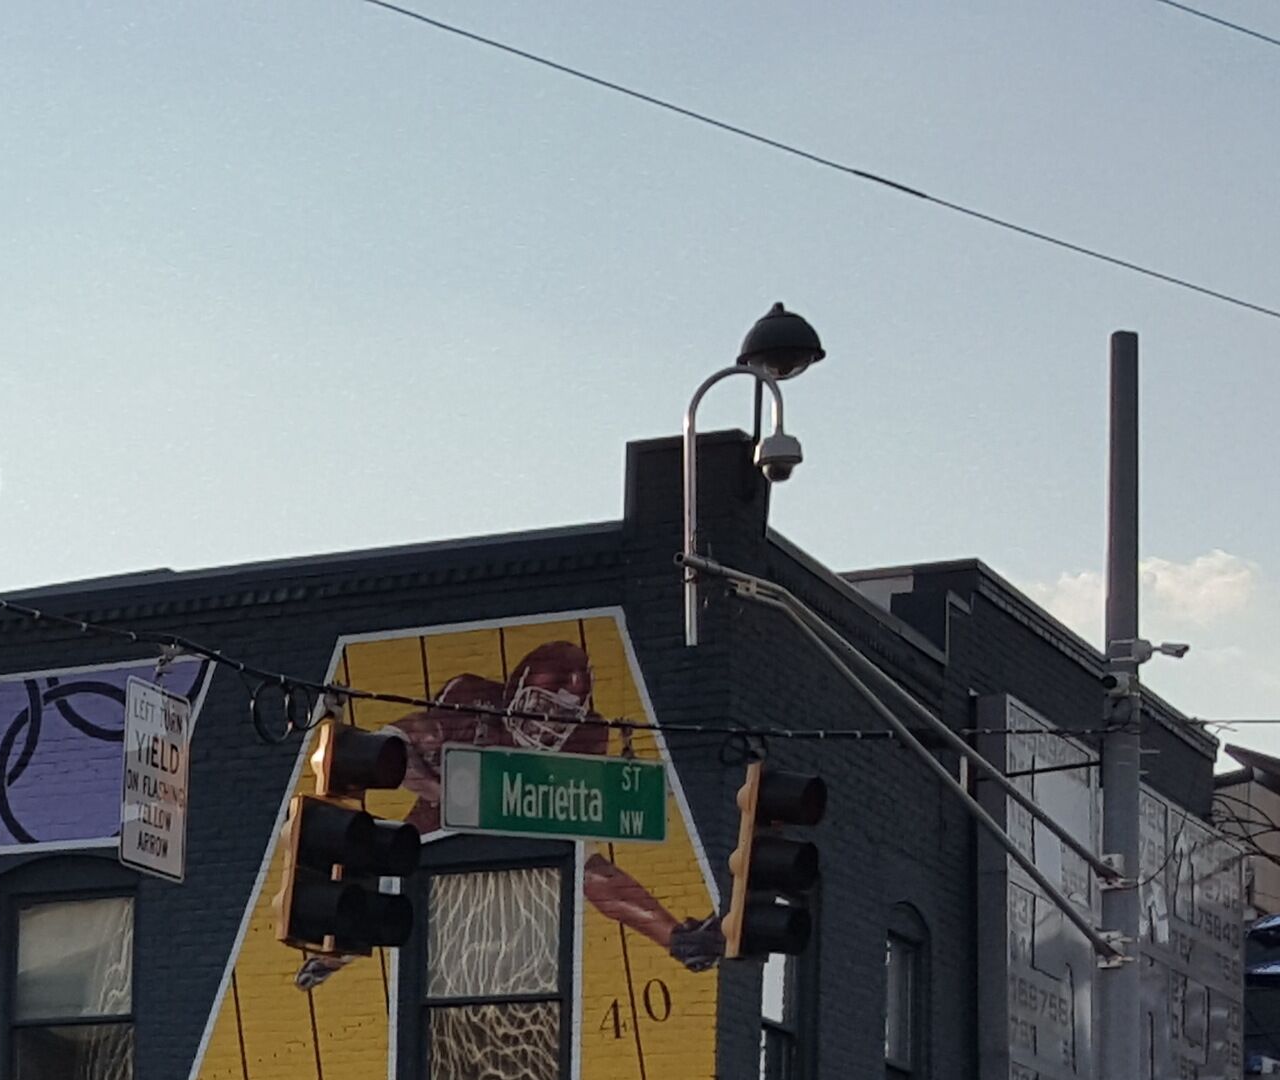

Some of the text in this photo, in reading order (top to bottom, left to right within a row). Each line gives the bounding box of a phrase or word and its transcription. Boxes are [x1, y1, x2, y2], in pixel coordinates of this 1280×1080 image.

[133, 697, 183, 736] LEFT TURN
[135, 730, 180, 776] YIELD
[126, 768, 185, 808] ON FLASHING
[502, 766, 641, 823] Marietta ST
[136, 800, 172, 833] YELLOW
[620, 810, 644, 835] NW
[136, 830, 168, 860] ARROW
[599, 977, 672, 1040] 40
